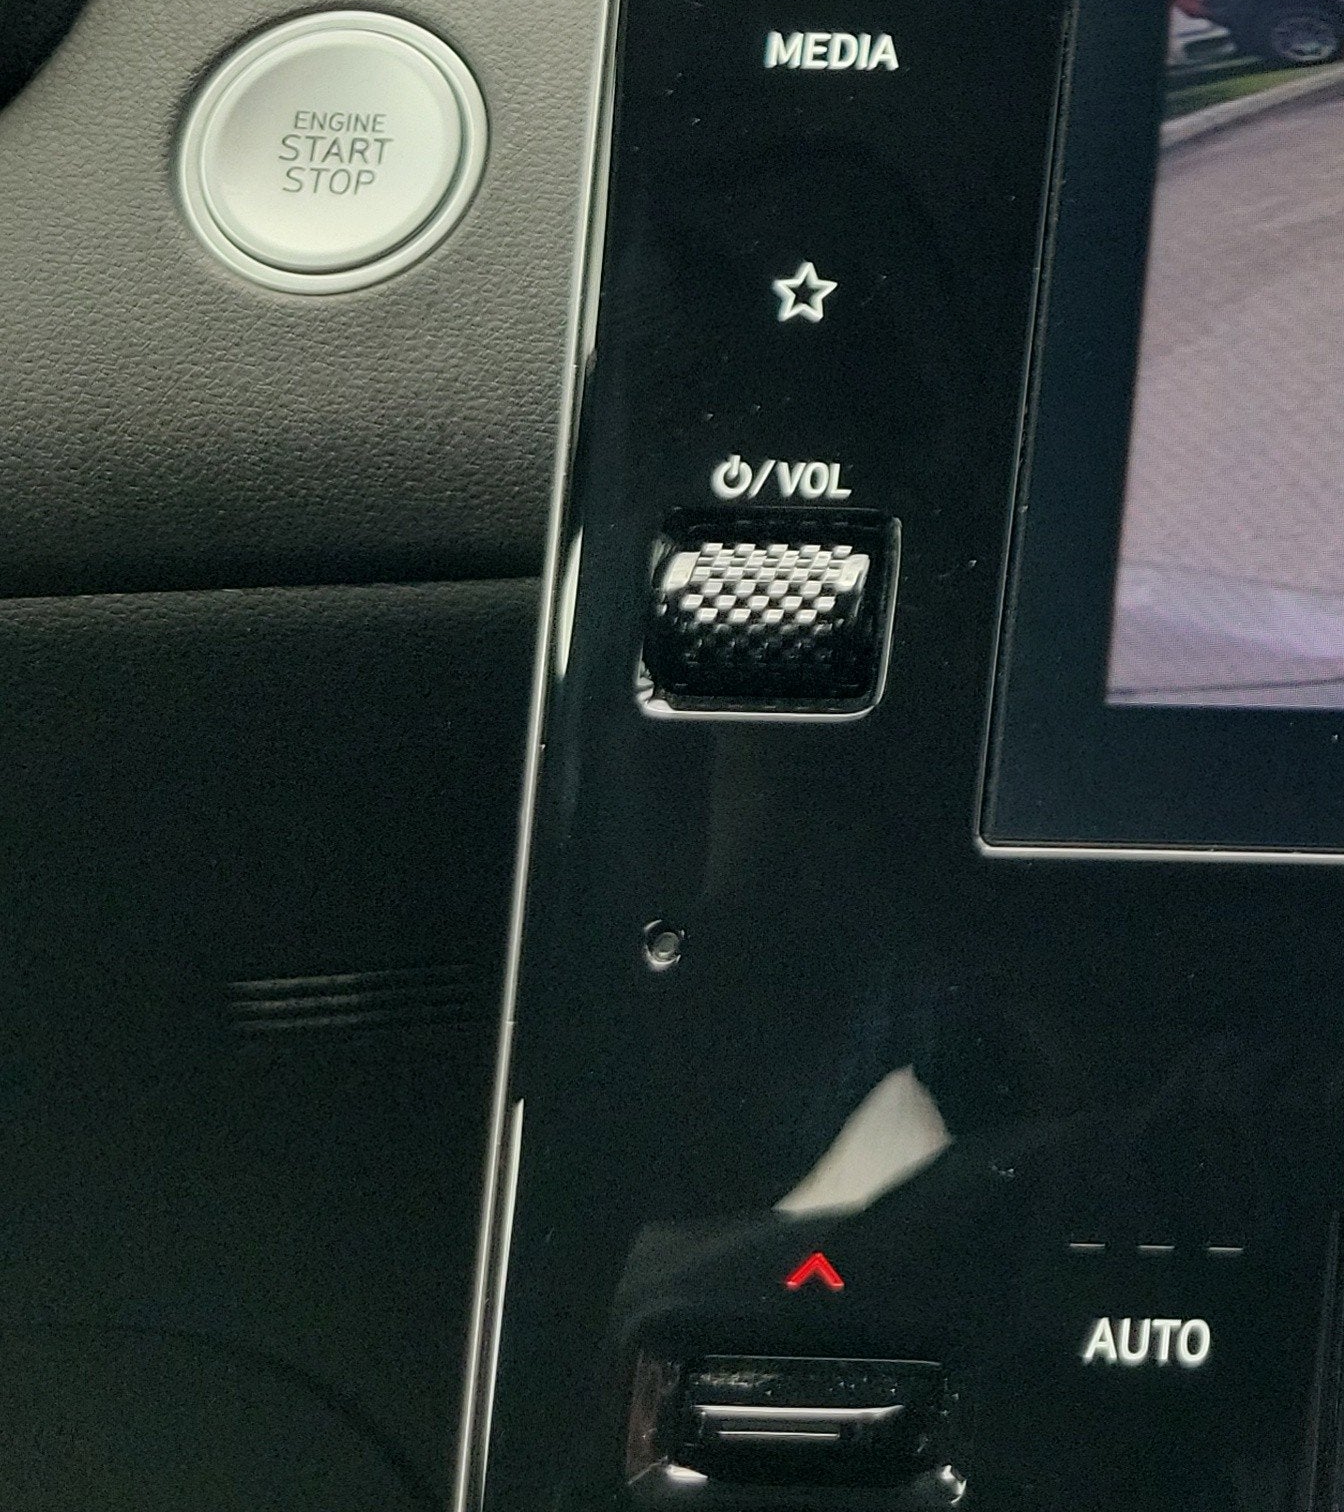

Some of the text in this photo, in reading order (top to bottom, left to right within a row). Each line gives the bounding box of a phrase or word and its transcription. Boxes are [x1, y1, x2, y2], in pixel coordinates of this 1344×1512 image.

[762, 30, 901, 72] MEDIA
[293, 110, 388, 134] ENGINE
[278, 133, 395, 165] START
[282, 166, 376, 196] STOP
[1081, 1316, 1212, 1368] AUTO
